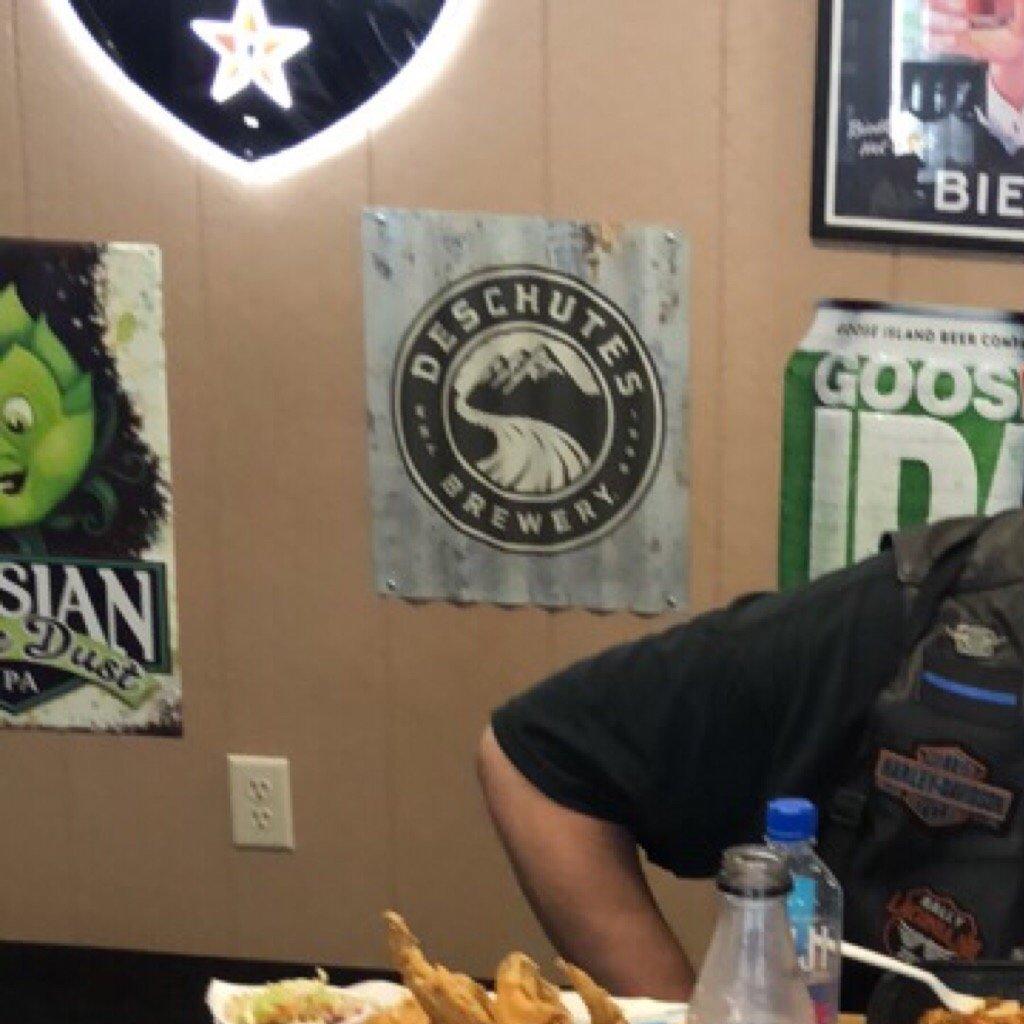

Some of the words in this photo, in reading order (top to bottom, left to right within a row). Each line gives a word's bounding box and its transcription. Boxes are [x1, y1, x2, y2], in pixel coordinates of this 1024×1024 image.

[410, 283, 643, 398] DESCHUTES
[883, 327, 936, 343] ISLAND
[940, 329, 977, 347] BEER
[440, 472, 615, 536] BREWERY
[24, 615, 146, 690] Dust
